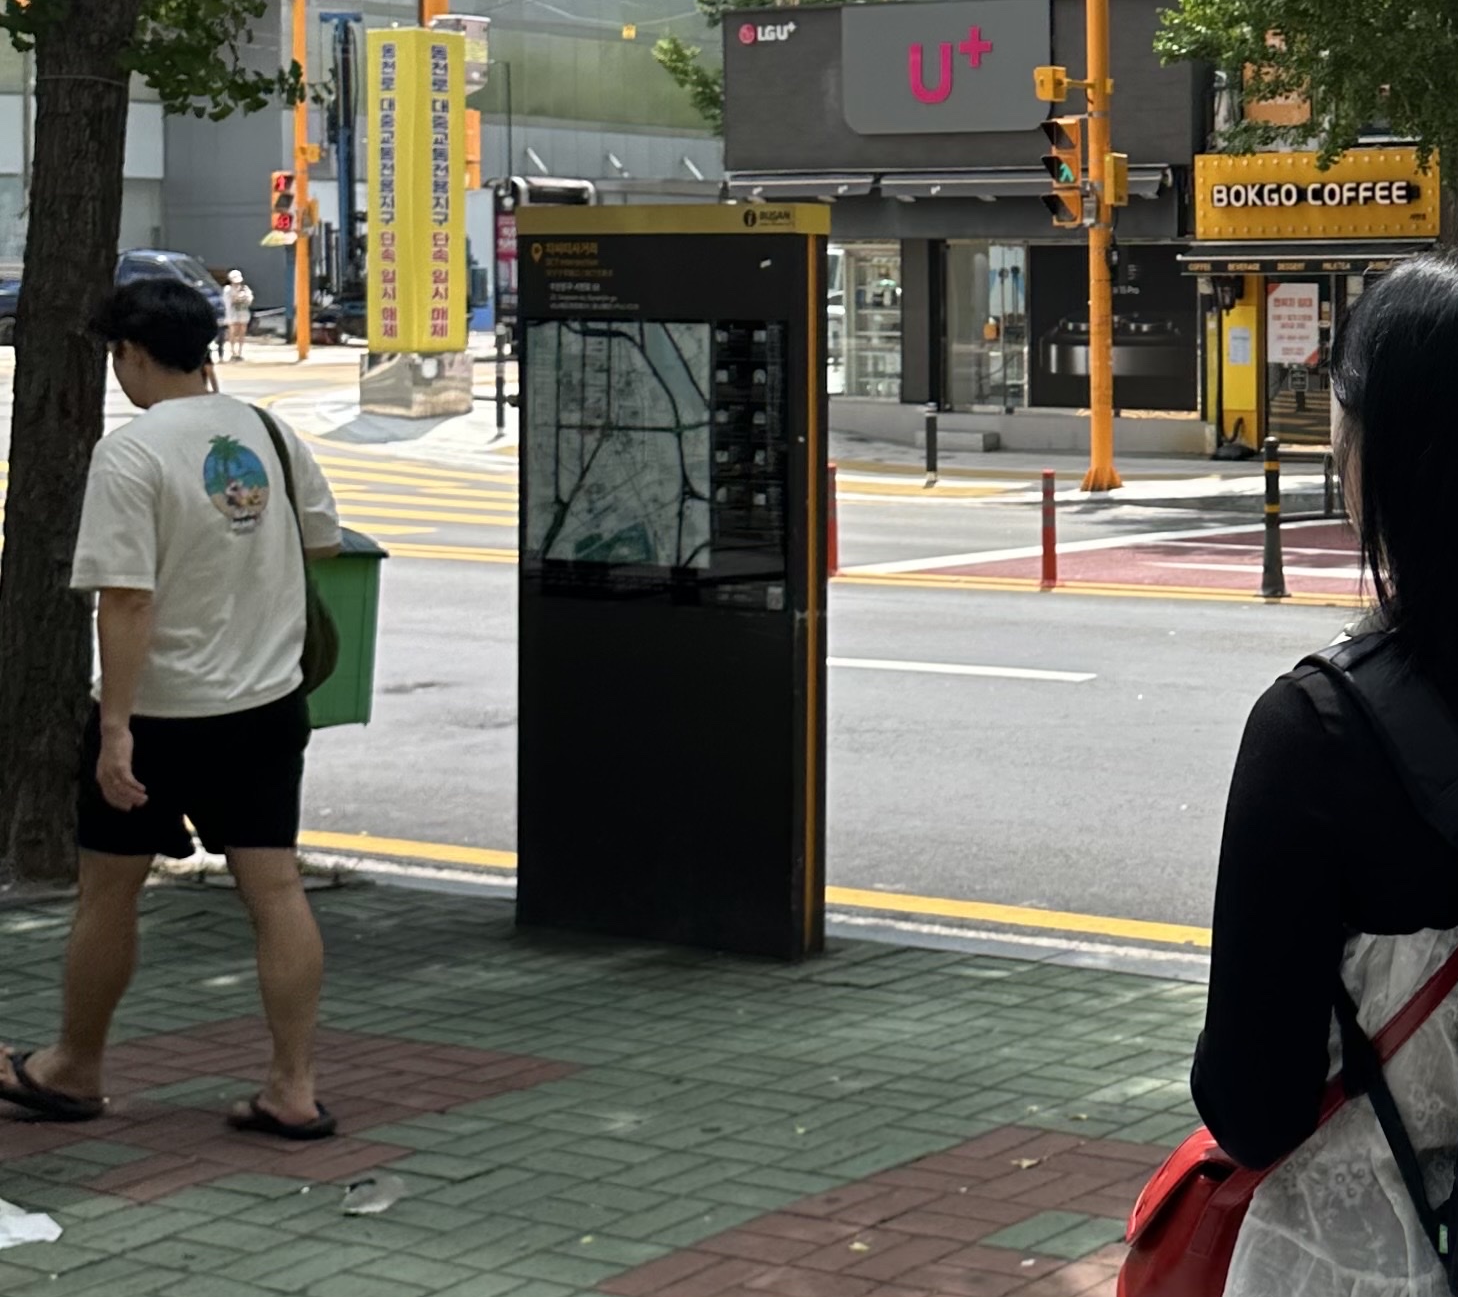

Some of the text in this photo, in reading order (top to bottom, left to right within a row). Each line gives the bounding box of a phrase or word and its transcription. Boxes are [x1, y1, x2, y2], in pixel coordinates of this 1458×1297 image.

[908, 25, 993, 104] U+
[1212, 180, 1409, 207] BOKGO COFFEE
[759, 210, 791, 220] BUSAN
[380, 231, 396, 263] 단속
[431, 232, 450, 264] 단속
[381, 269, 397, 301] 일시
[431, 269, 449, 301] 일시
